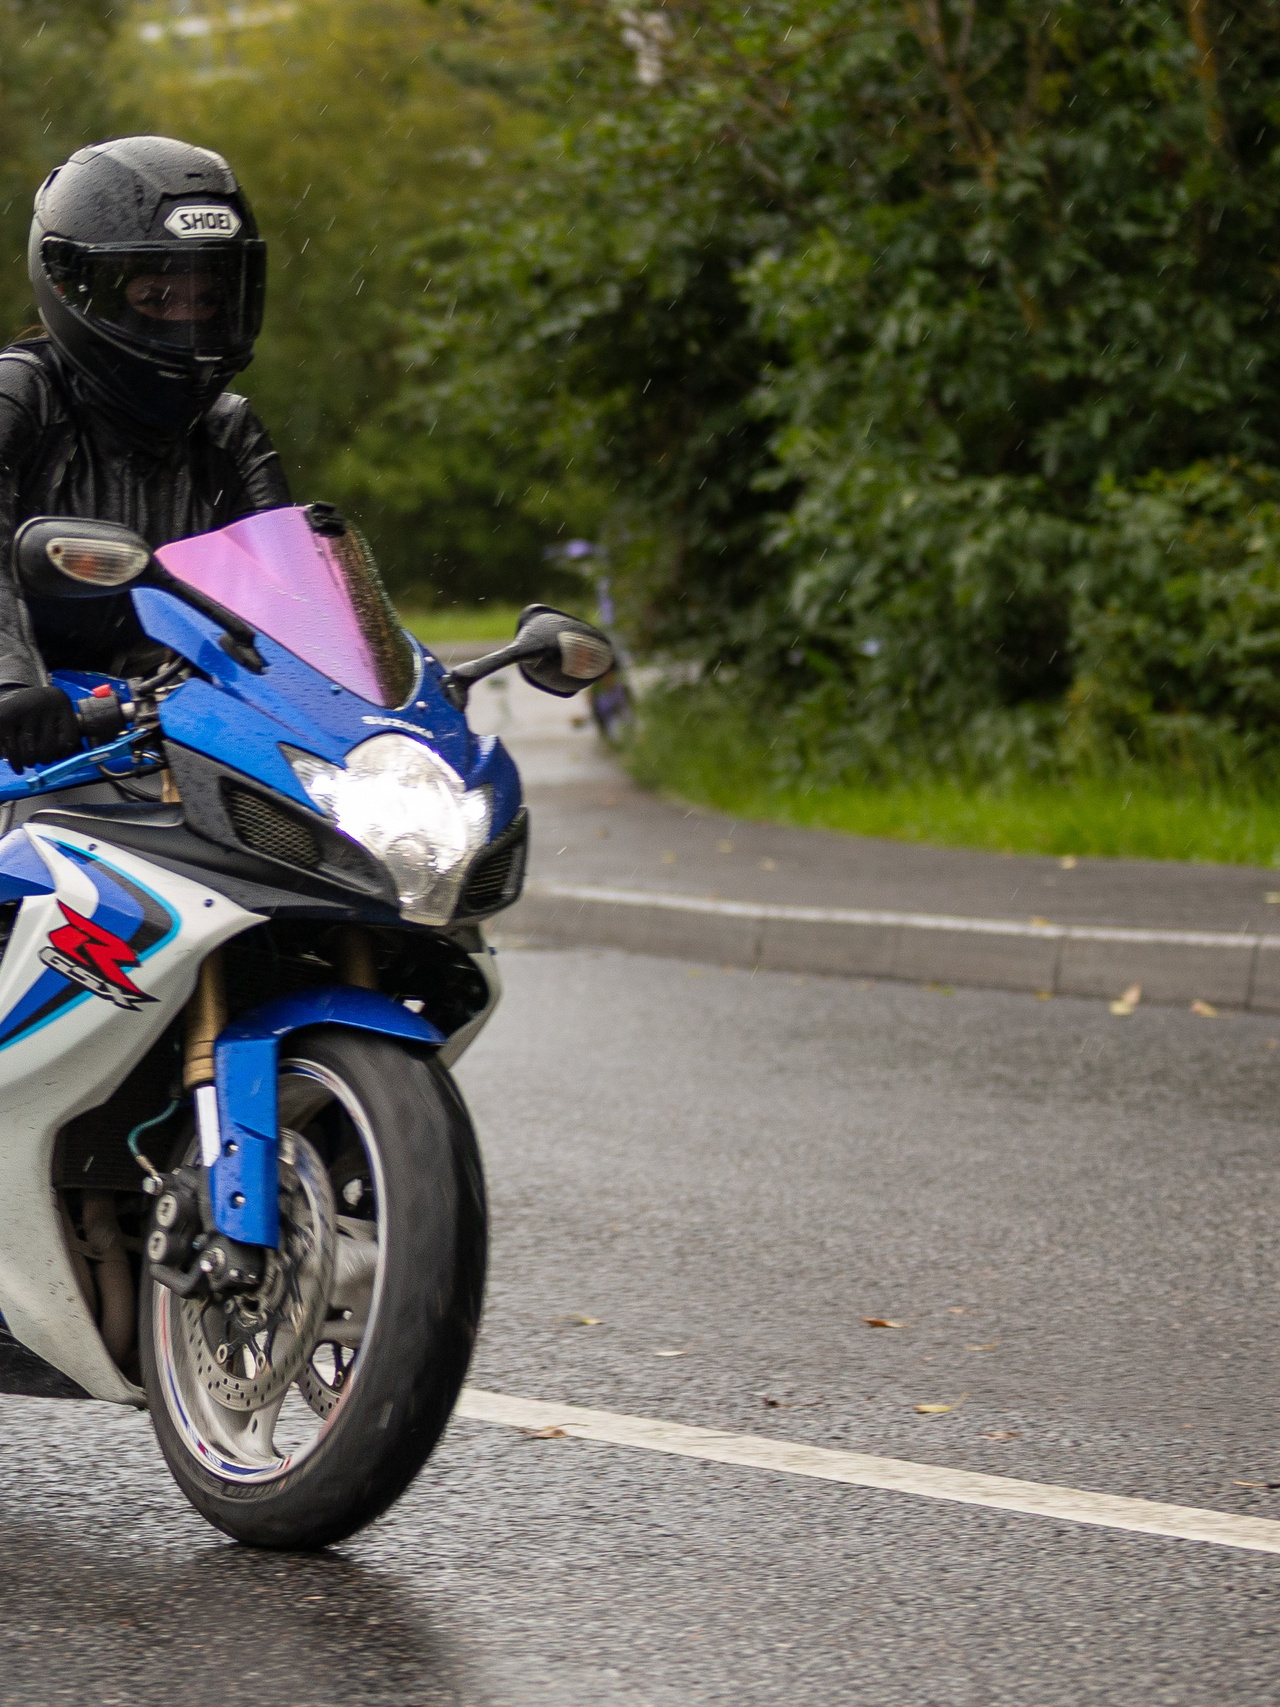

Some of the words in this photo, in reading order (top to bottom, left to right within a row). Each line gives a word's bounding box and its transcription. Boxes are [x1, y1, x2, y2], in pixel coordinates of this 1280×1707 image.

[180, 212, 232, 230] SHOEI
[38, 946, 144, 1011] GSX
[48, 898, 143, 996] R
